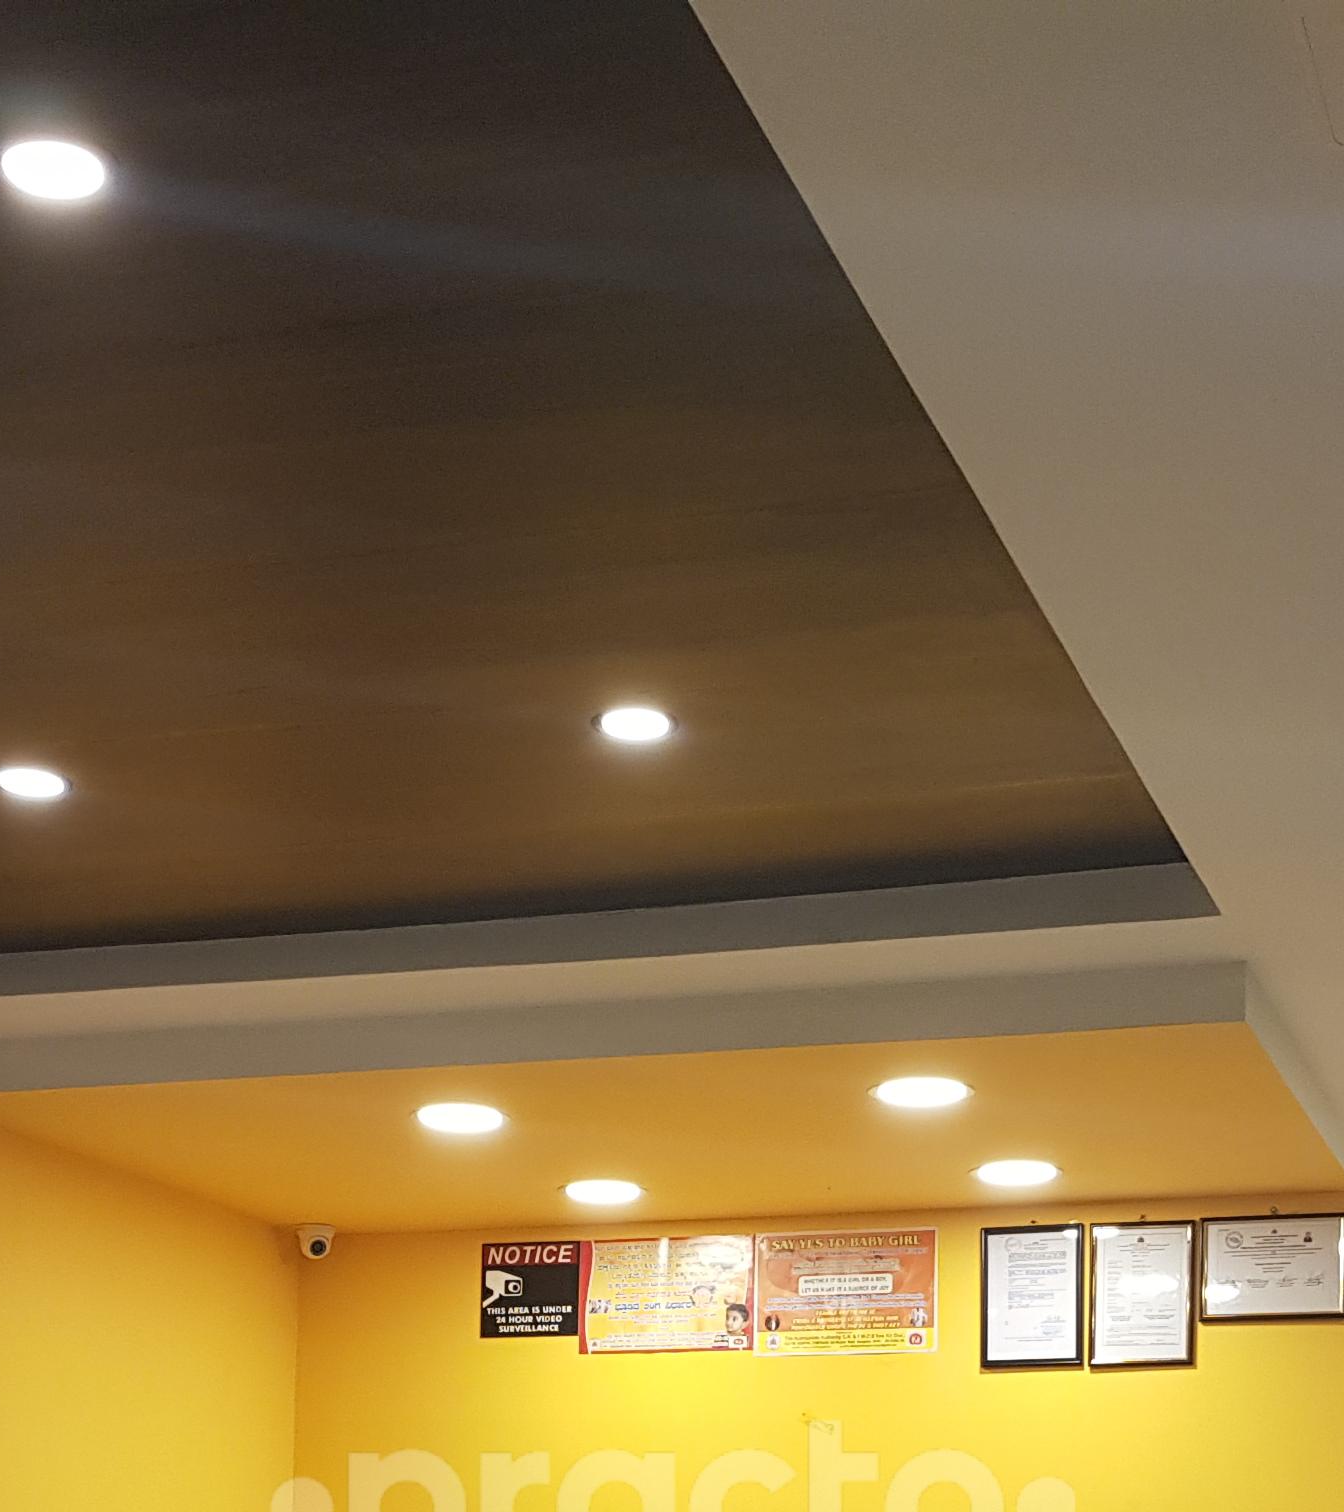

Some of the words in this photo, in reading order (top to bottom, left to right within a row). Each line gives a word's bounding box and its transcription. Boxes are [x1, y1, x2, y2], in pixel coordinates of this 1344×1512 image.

[771, 1239, 796, 1251] SAY
[829, 1237, 846, 1248] TO
[850, 1236, 886, 1248] BABY
[889, 1235, 920, 1246] GIRL
[487, 1244, 573, 1265] NOTICE
[487, 1307, 506, 1315] THIS
[508, 1306, 529, 1314] AREA
[532, 1306, 540, 1314] IS
[542, 1305, 573, 1313] UNDER
[496, 1316, 506, 1324] 24
[508, 1315, 534, 1323] HOUR
[498, 1324, 560, 1333] SURVEILLANCE
